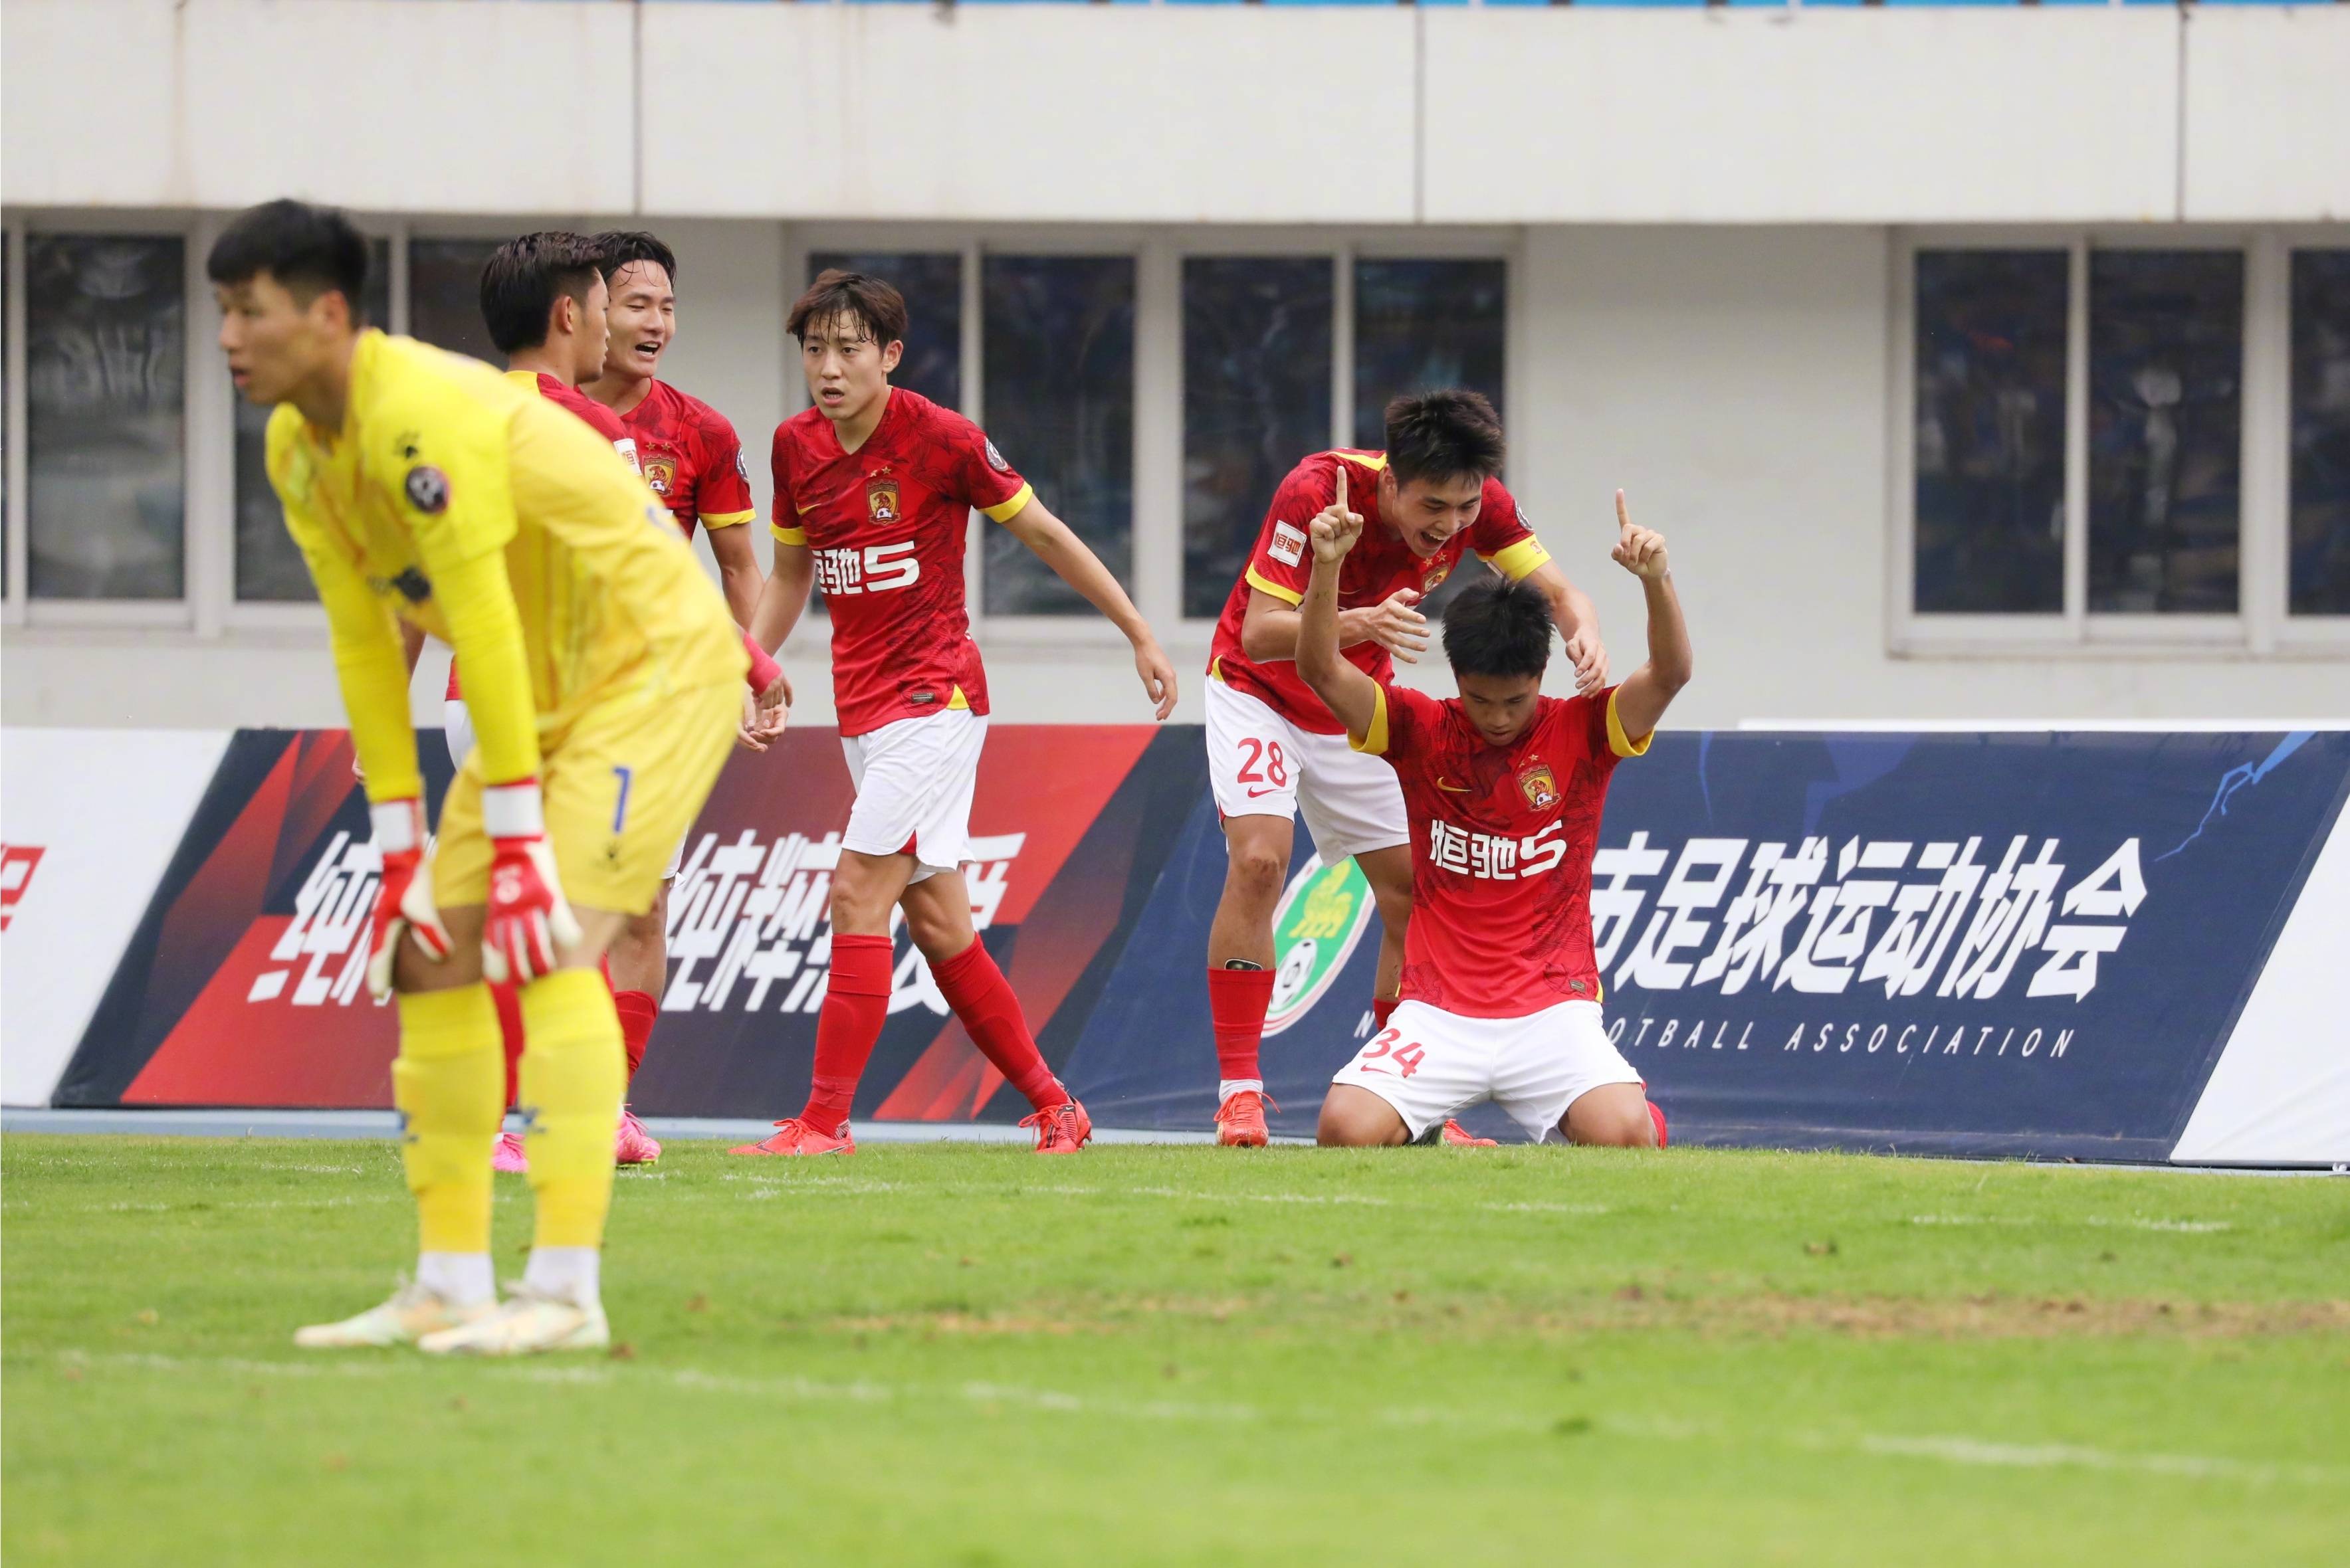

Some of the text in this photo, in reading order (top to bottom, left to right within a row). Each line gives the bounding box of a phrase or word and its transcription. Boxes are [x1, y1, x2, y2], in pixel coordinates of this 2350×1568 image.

[1275, 532, 1301, 555] 恒驰
[1237, 737, 1287, 787] 28
[613, 766, 631, 834] 1
[1430, 819, 1567, 880] 恒驰5
[1362, 1028, 1426, 1078] 34
[1607, 1017, 2074, 1058] OTBALL ASSOCIATION
